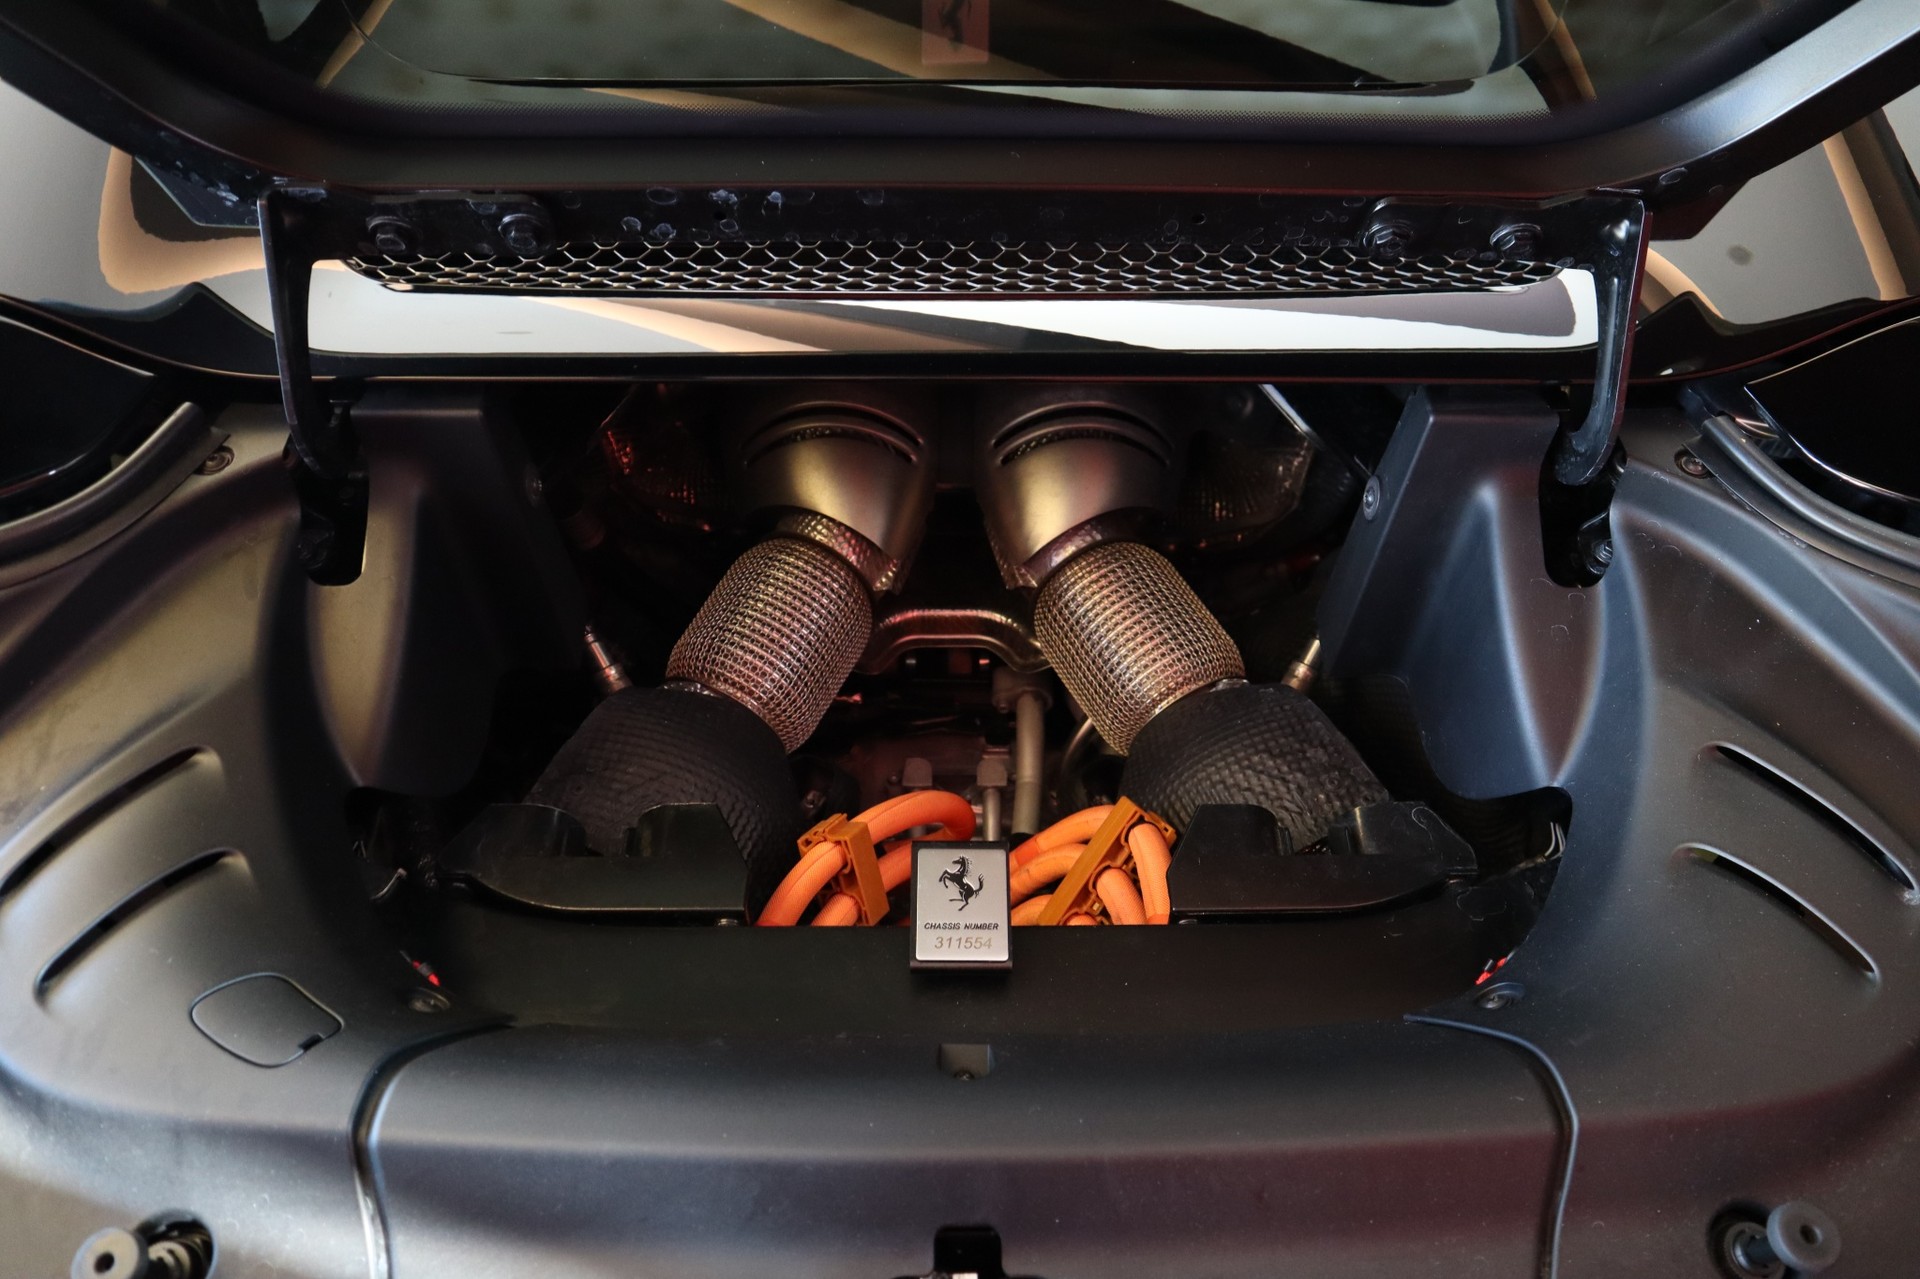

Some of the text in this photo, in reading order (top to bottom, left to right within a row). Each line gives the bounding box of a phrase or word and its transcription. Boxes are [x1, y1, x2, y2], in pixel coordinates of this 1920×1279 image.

[924, 922, 999, 930] CHASSIS NUMBER
[934, 936, 993, 949] 311554
